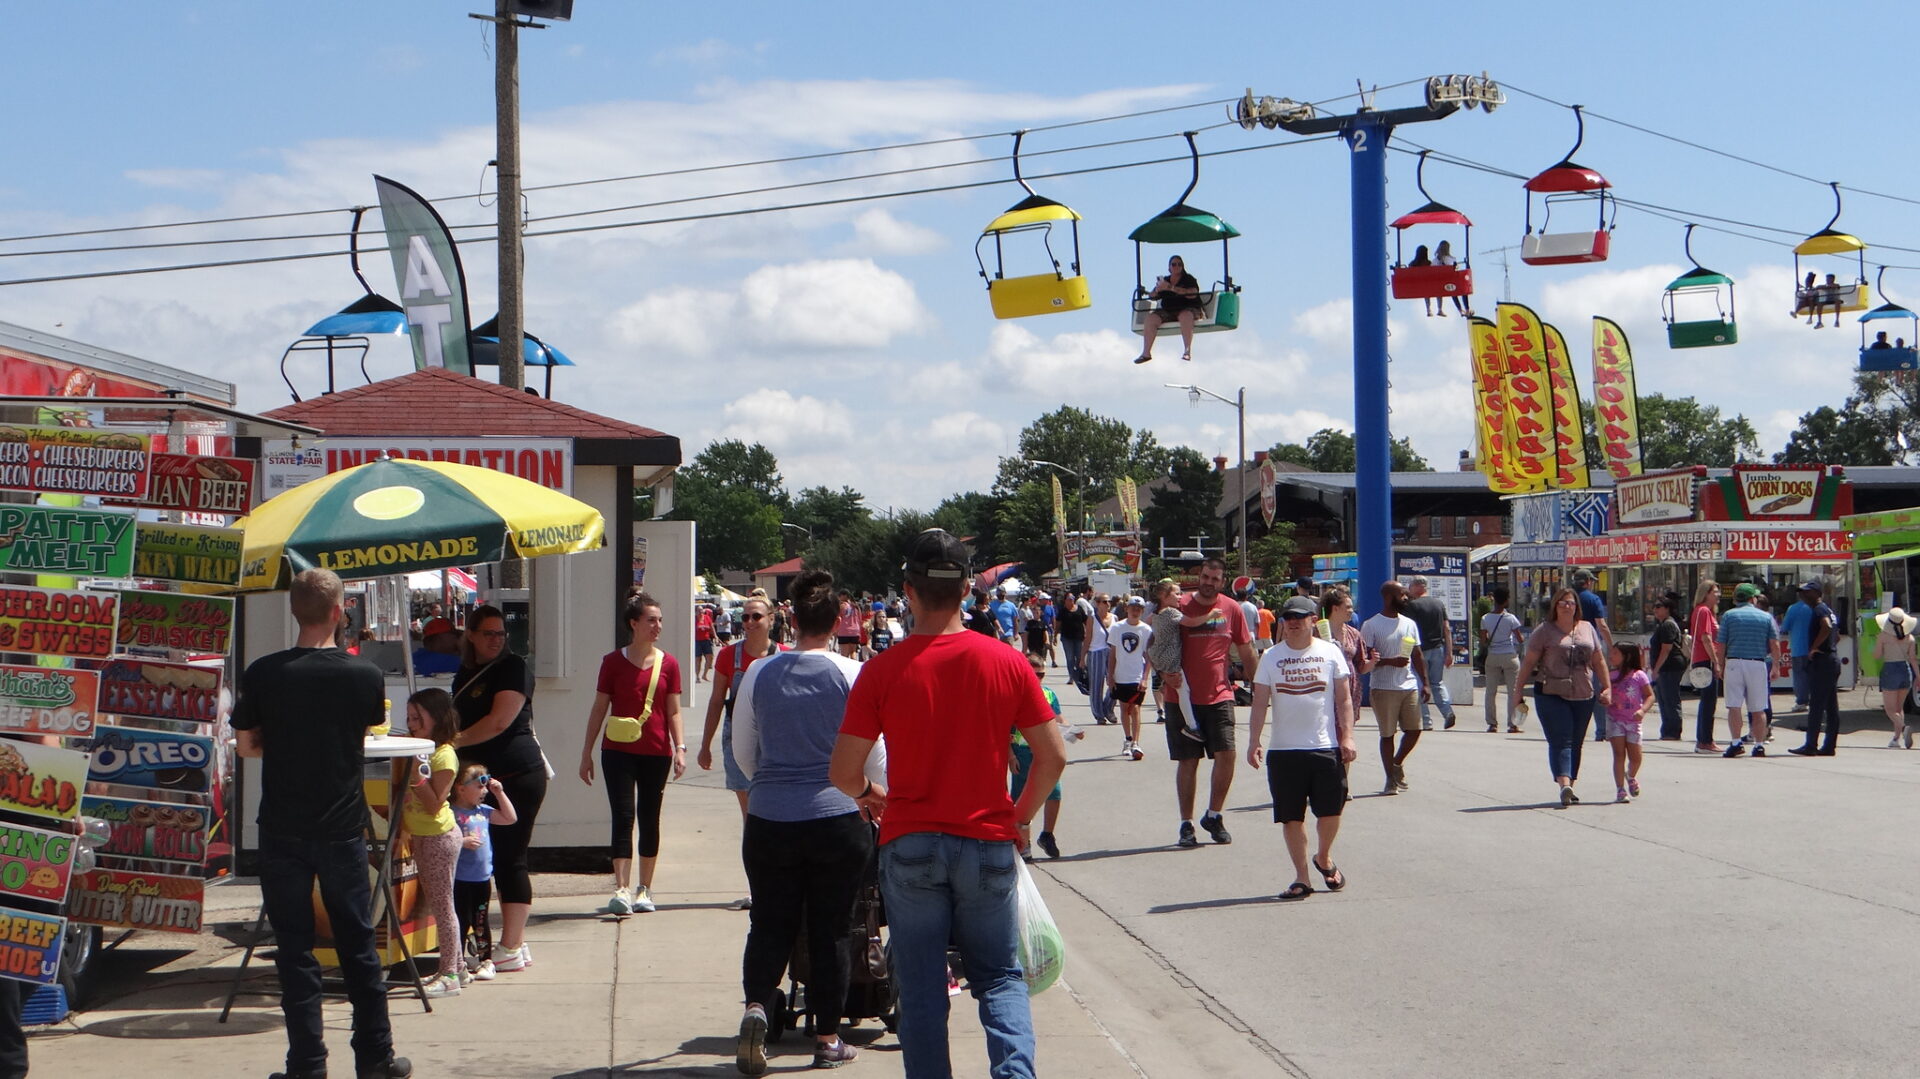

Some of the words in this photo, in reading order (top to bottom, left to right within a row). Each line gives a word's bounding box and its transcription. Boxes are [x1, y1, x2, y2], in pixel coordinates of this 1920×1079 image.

[1353, 129, 1368, 153] 2
[30, 428, 58, 441] Hand
[43, 443, 146, 472] CHEESEBURGERS
[268, 456, 296, 465] STATE
[303, 456, 323, 465] FAIR
[34, 465, 138, 494] CHEESEBURGERS
[1745, 473, 1782, 483] Jumbo
[1748, 482, 1781, 501] CORN
[1781, 480, 1814, 498] DOGS
[197, 477, 248, 512] BEEF
[1620, 482, 1655, 518] PHILLY
[1655, 476, 1691, 508] STEAK
[0, 508, 133, 545] PATTY
[517, 523, 586, 549] LEMONADE
[1659, 532, 1722, 543] STRAWBERRY
[6, 538, 116, 573] MELT
[179, 536, 194, 547] or
[196, 533, 241, 555] Krispy
[318, 536, 480, 571] LEMONADE
[1660, 550, 1722, 561] ORANGE
[1726, 530, 1781, 559] Philly
[1785, 531, 1838, 552] Steak
[183, 554, 240, 582] WRAP
[1443, 556, 1463, 569] Lite
[0, 623, 17, 647] &
[18, 621, 112, 655] SWISS
[135, 623, 228, 654] BASKET
[1281, 665, 1322, 675] Instant
[1283, 655, 1325, 666] Maruchan
[1285, 674, 1319, 683] Lunch
[38, 708, 91, 732] DOG
[89, 741, 205, 775] OREO
[153, 825, 206, 861] ROLLS
[97, 872, 128, 896] Deep
[127, 877, 161, 897] Fried
[130, 894, 202, 932] BUTTER
